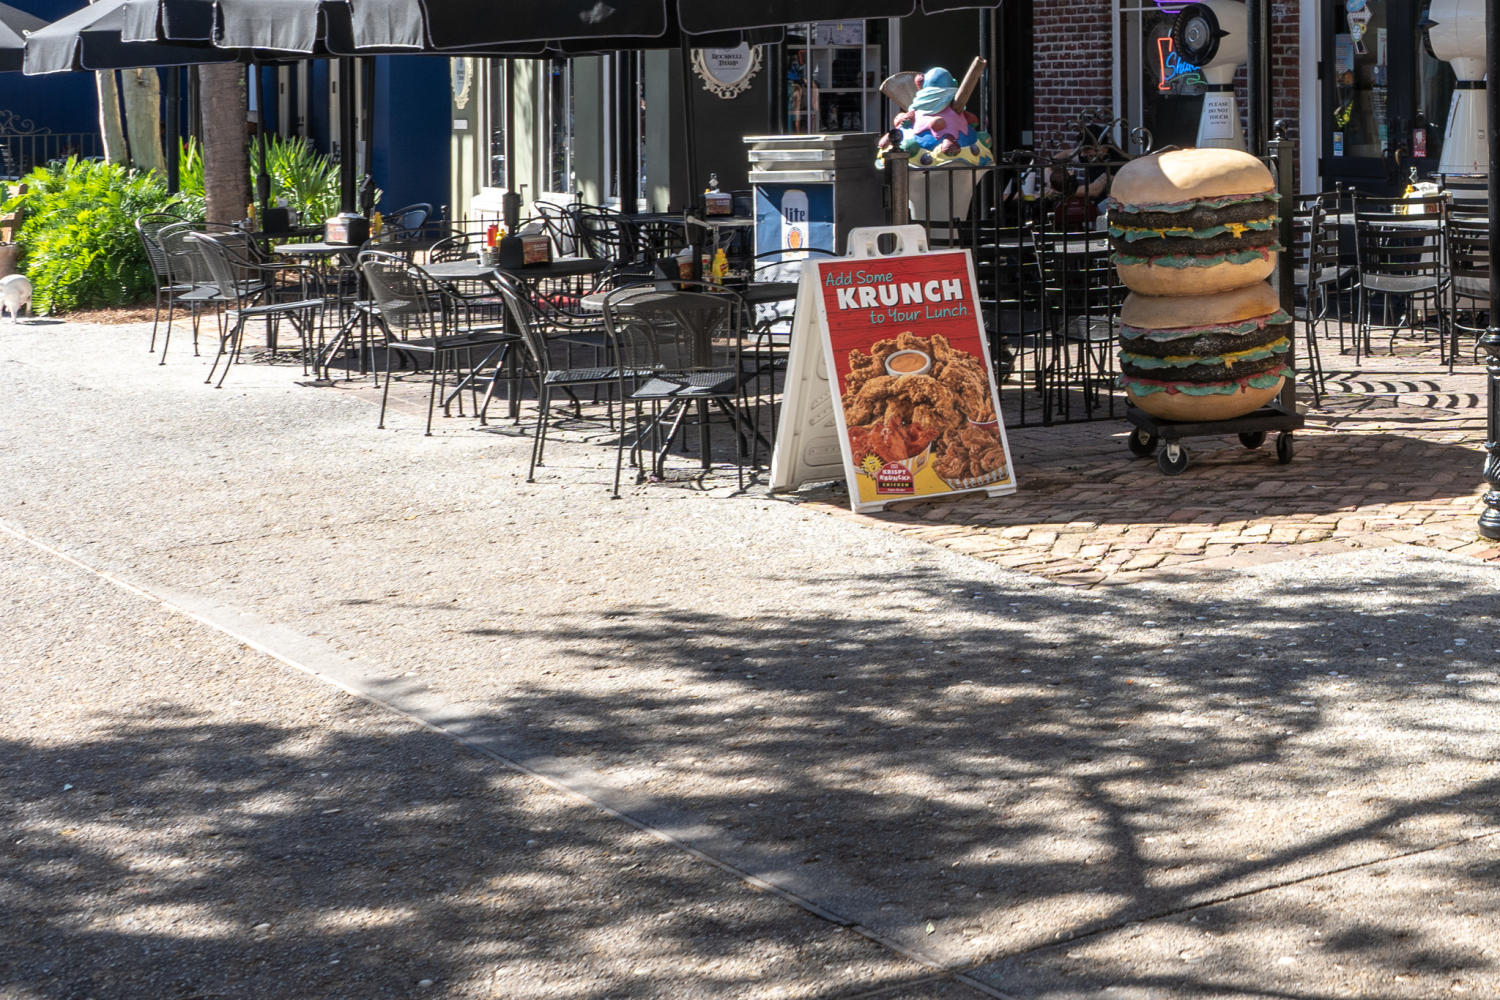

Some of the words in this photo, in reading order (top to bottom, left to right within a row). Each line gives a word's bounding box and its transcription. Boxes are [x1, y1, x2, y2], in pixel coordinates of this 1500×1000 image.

[825, 271, 852, 287] Add
[856, 270, 894, 285] Some
[836, 278, 964, 310] KRUNCH
[870, 310, 885, 324] to
[887, 308, 921, 323] Your
[925, 302, 968, 320] Lunch
